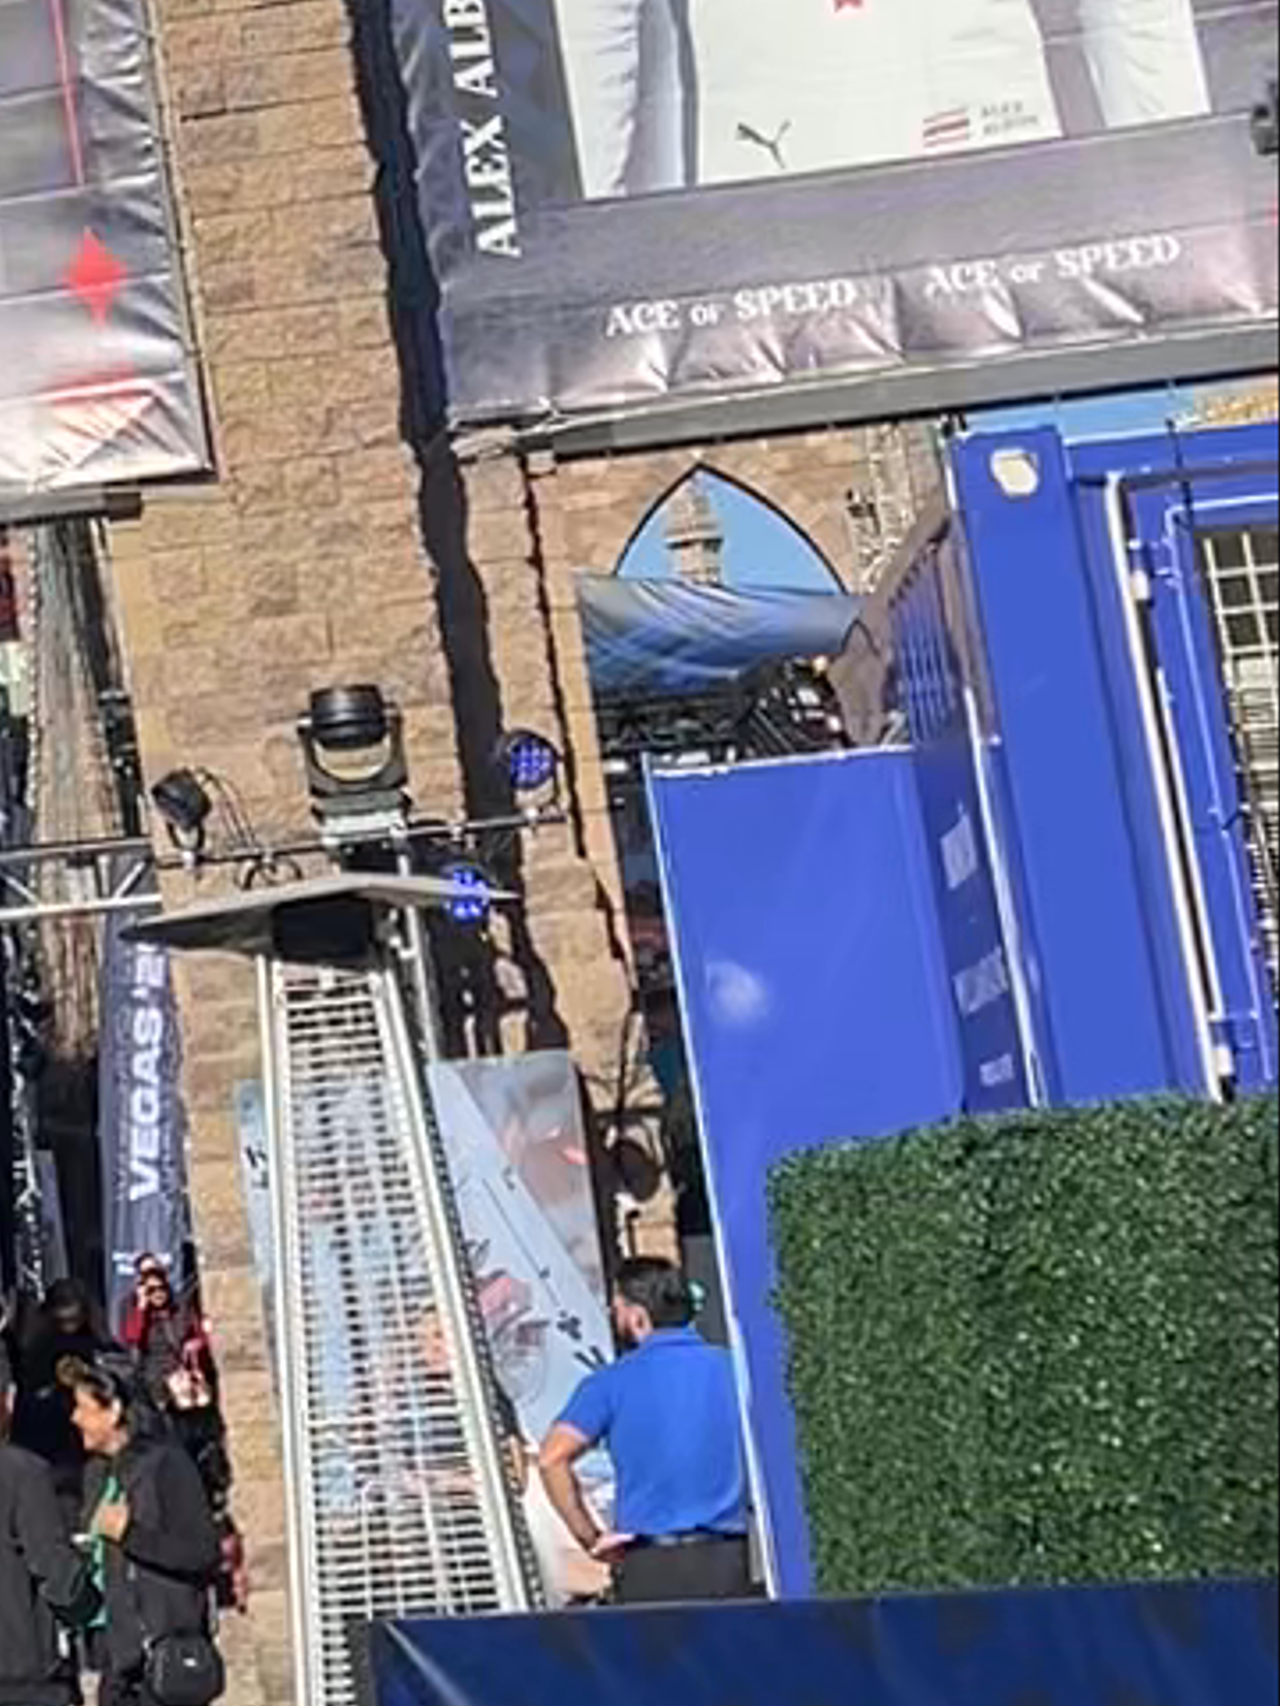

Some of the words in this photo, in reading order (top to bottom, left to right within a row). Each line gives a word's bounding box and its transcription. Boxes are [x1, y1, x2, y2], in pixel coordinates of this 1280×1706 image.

[459, 115, 522, 259] ALEX
[1055, 234, 1182, 281] SPEED
[606, 302, 681, 338] ACE
[734, 279, 857, 322] SPEED
[129, 1006, 165, 1202] VEGAS
